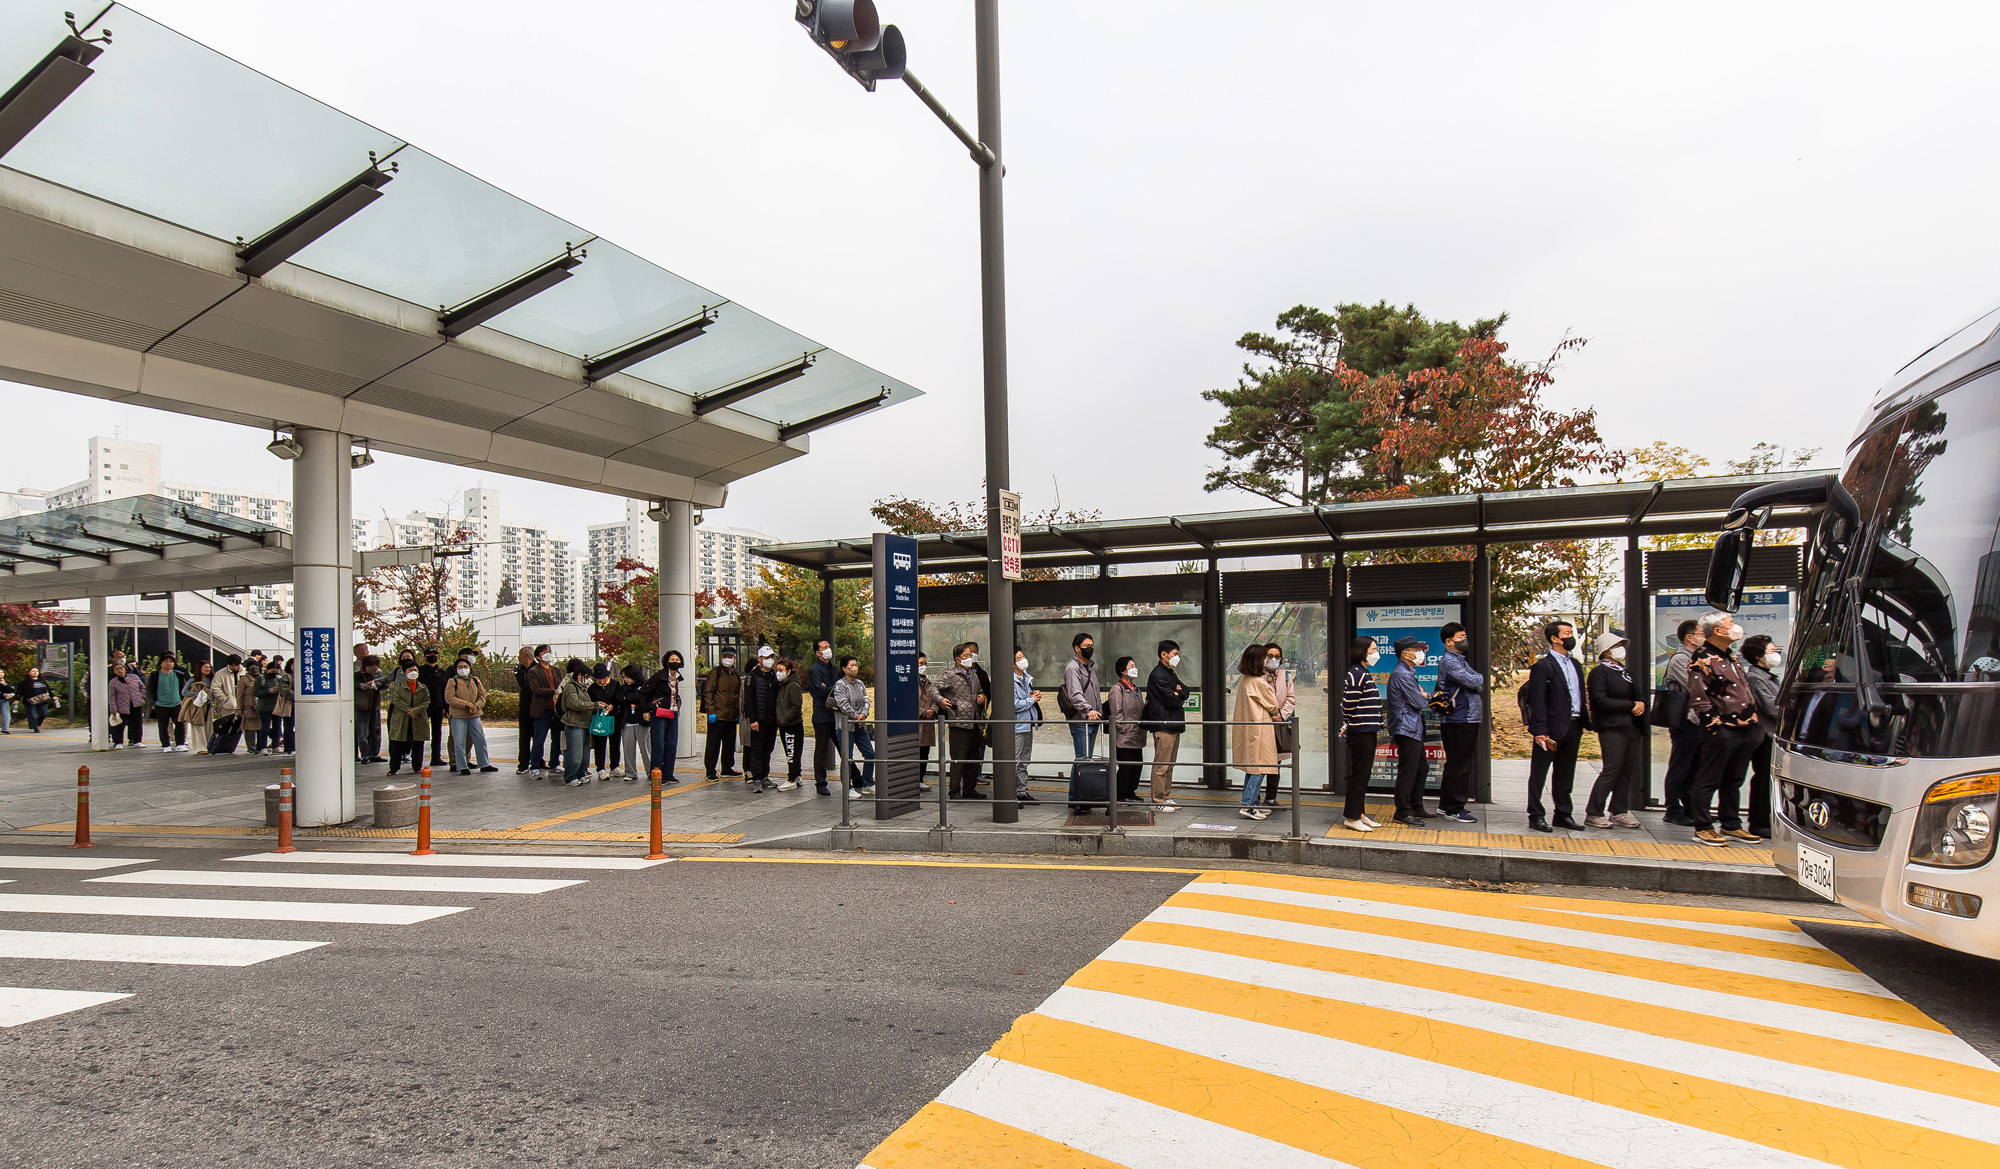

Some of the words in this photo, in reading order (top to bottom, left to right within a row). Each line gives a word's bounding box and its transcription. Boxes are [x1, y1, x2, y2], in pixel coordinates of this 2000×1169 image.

[1003, 536, 1019, 554] CCTV
[1004, 556, 1020, 574] 단속중
[1753, 593, 1774, 603] 전문
[320, 633, 331, 690] 영상단속지점
[895, 664, 905, 674] 타는
[905, 664, 911, 674] 곳
